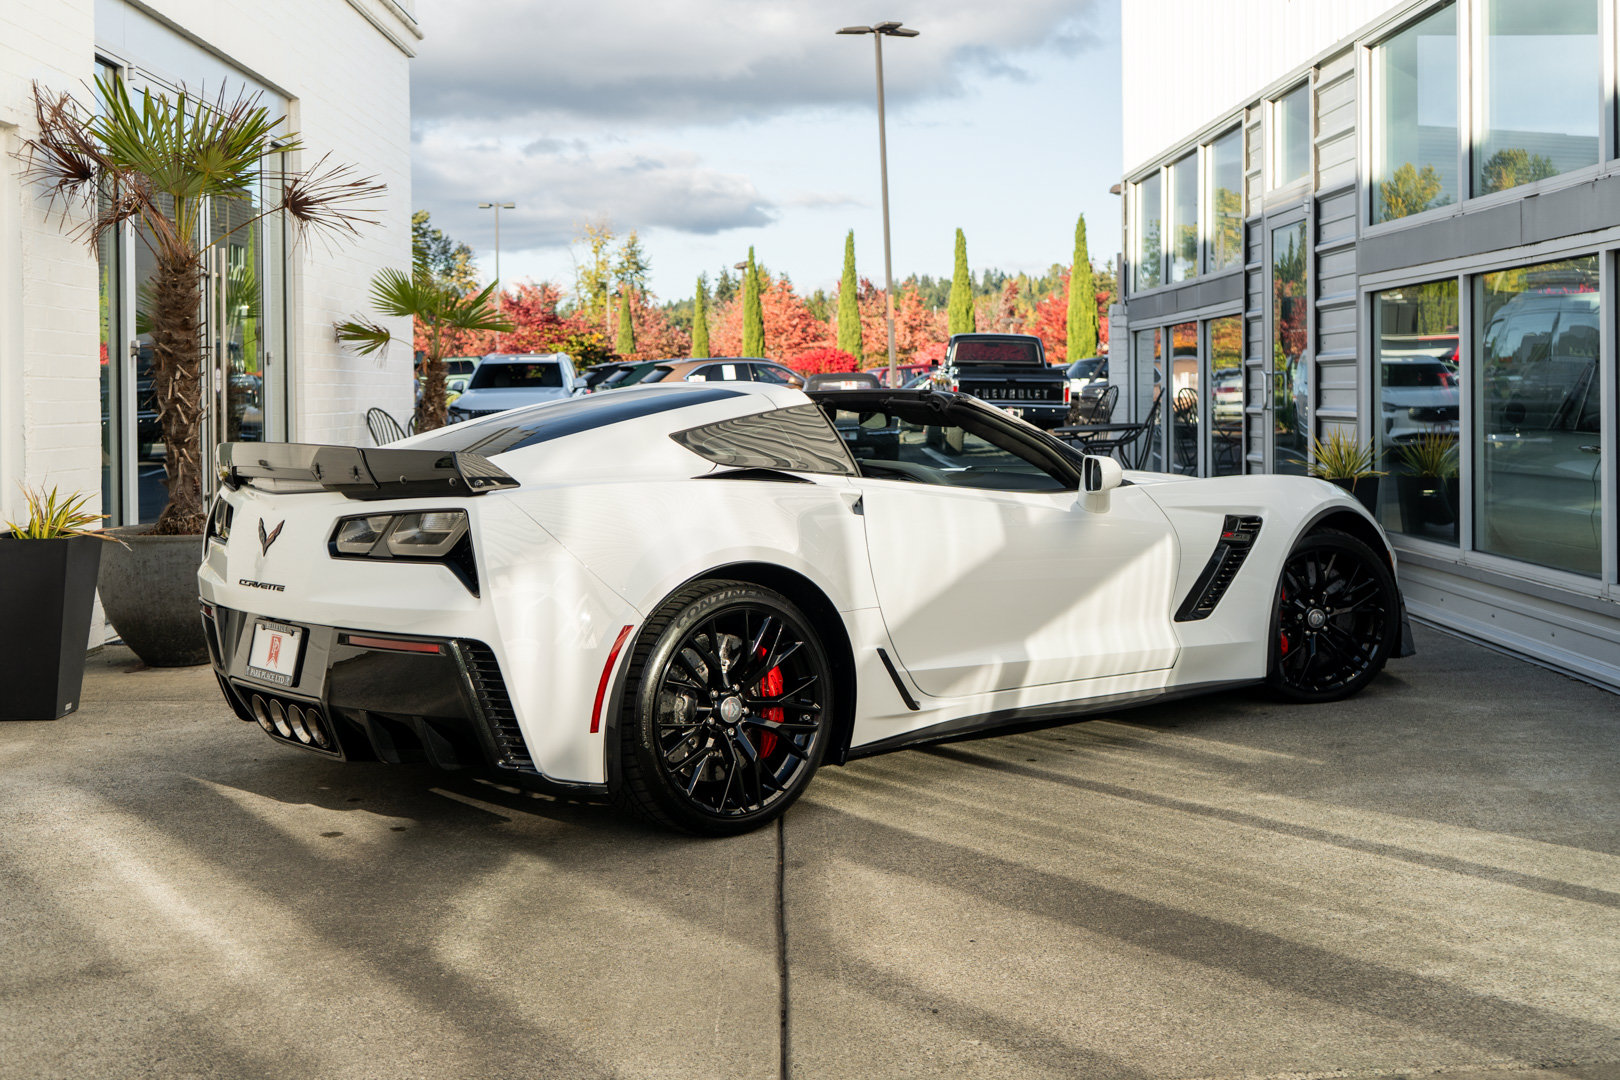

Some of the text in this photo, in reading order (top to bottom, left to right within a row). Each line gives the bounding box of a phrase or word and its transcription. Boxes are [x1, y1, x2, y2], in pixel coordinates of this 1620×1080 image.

[973, 388, 1049, 399] CHEVROLET
[239, 579, 286, 592] CORVETTE
[249, 667, 262, 679] PARK
[261, 671, 275, 682] PLACE
